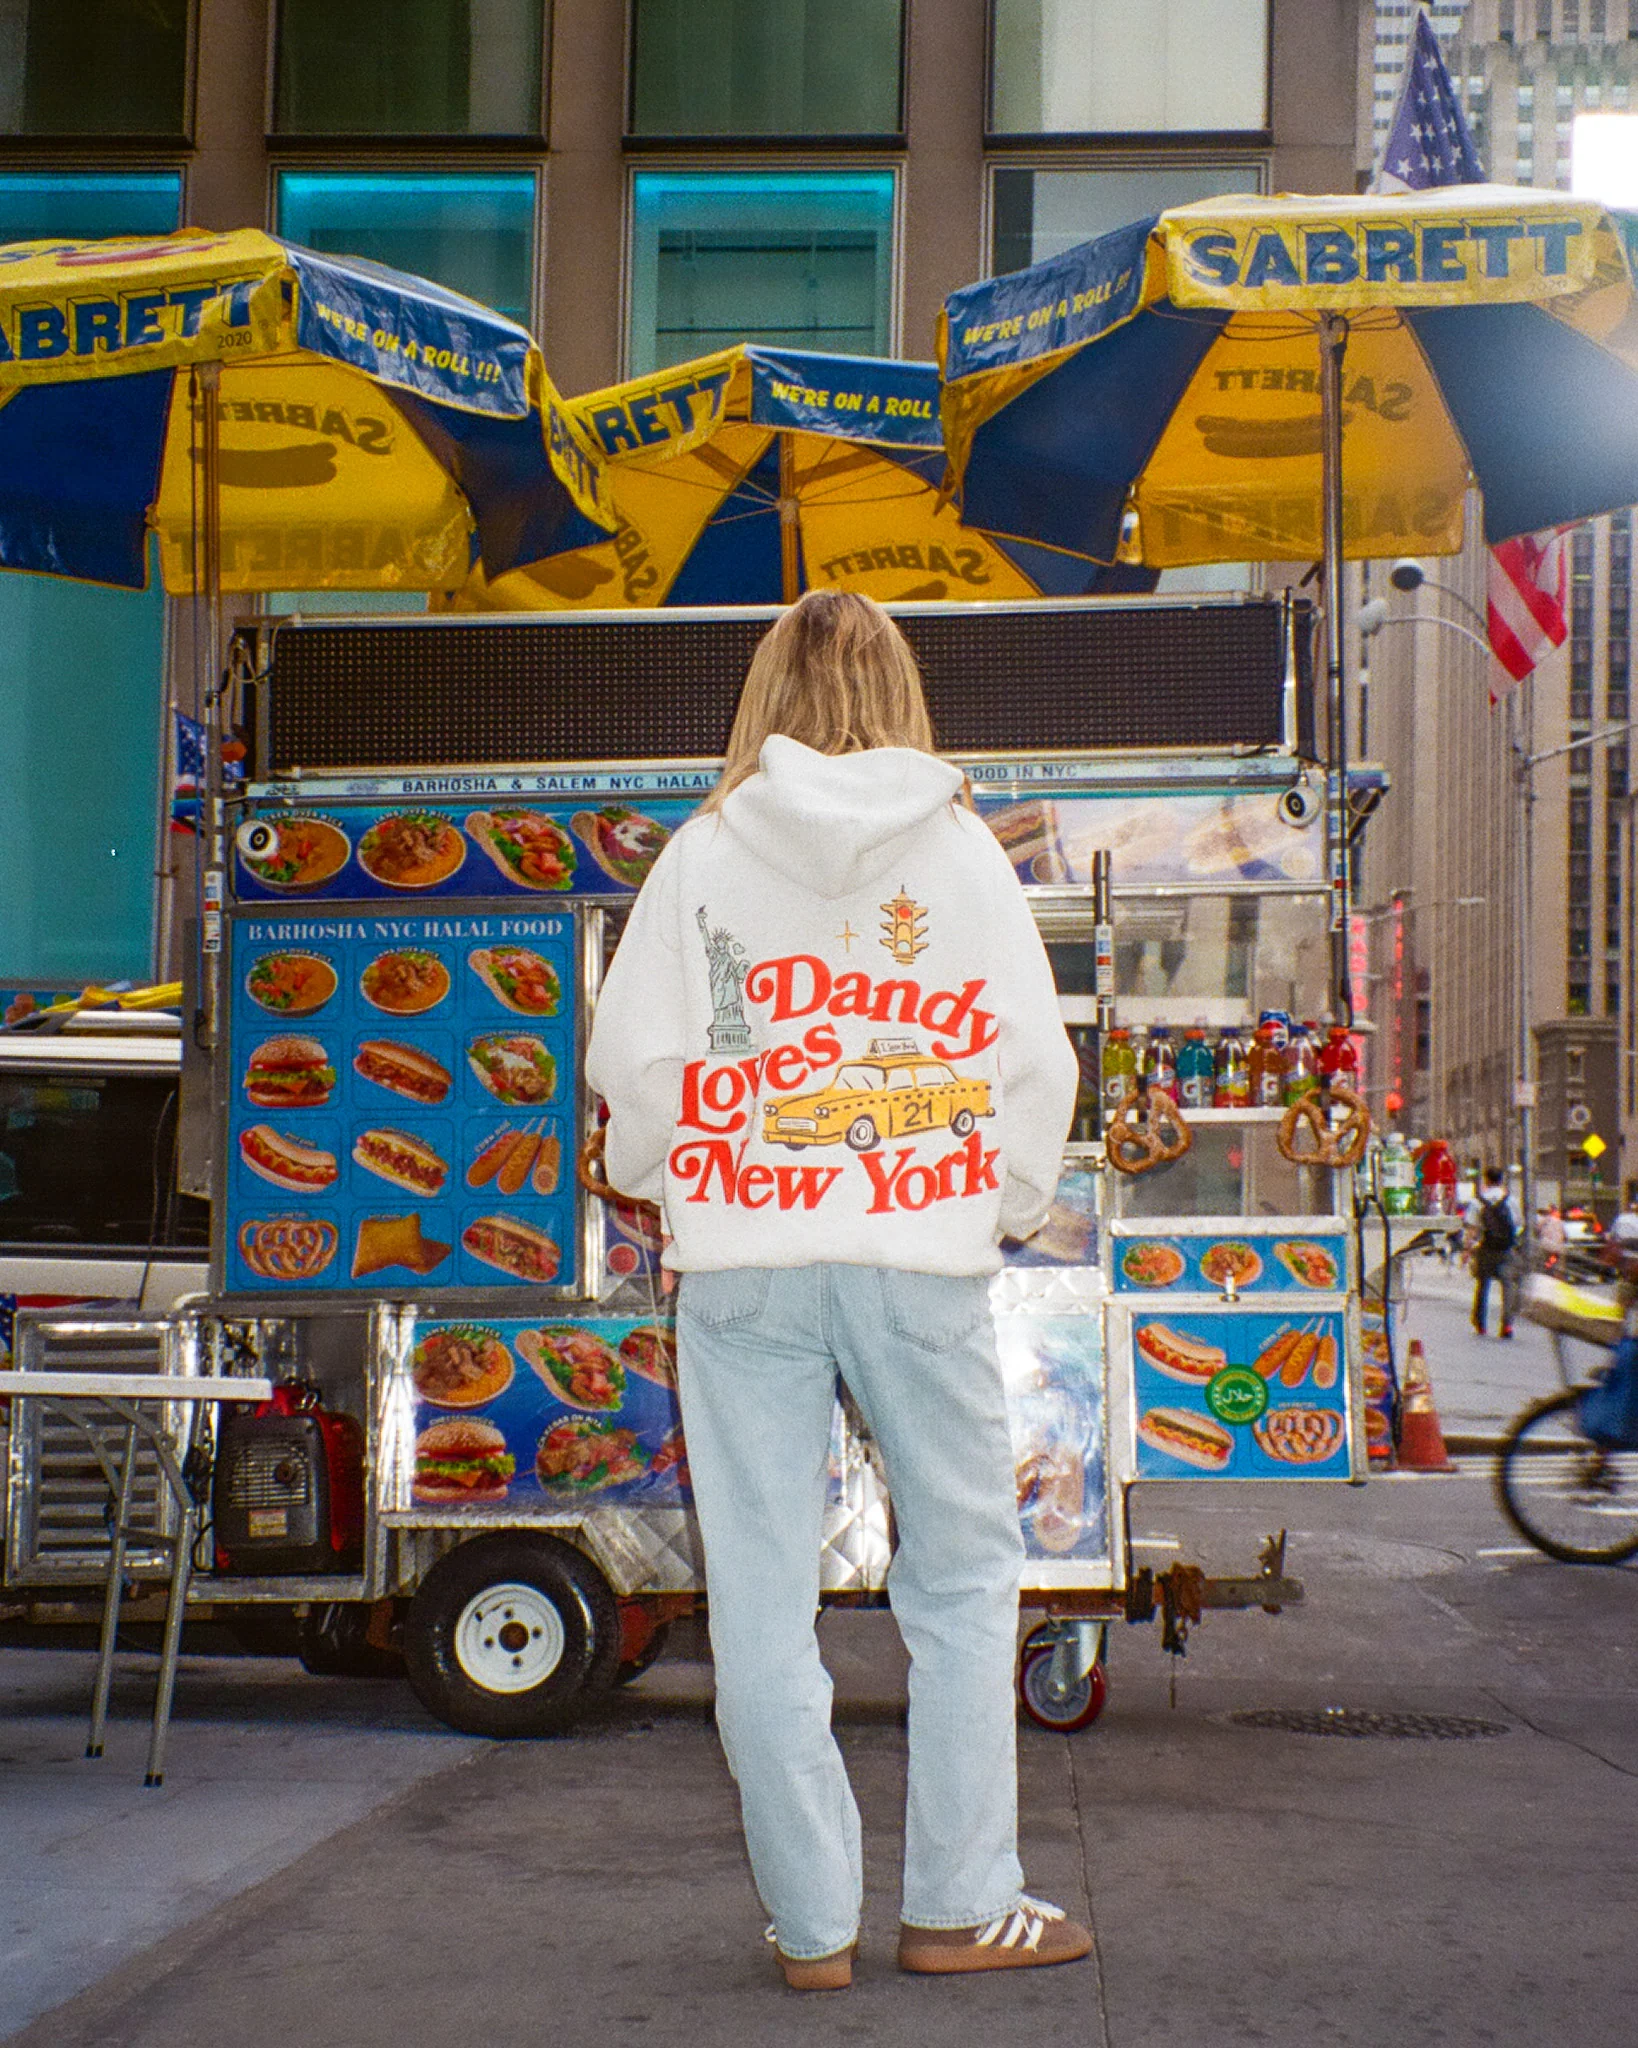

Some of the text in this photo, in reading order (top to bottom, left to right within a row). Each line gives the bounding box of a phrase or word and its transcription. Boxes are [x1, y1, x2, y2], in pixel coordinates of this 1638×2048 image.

[1183, 219, 1583, 288] SABRETT
[0, 273, 264, 361] BRETT
[1027, 305, 1054, 330] ON
[1056, 300, 1068, 318] A
[1072, 282, 1112, 314] ROLL
[217, 330, 252, 348] 2020
[372, 329, 399, 352] ON
[404, 340, 417, 360] A
[422, 345, 470, 376] ROLL
[834, 392, 863, 411] ON
[866, 395, 880, 414] A
[884, 397, 932, 420] ROLL
[402, 777, 497, 793] BARHOSHA
[511, 777, 522, 791] &
[536, 775, 596, 790] SALEM
[610, 776, 643, 789] NYC
[966, 767, 1008, 780] OOD
[1016, 766, 1033, 778] IN
[1043, 763, 1077, 777] NYC
[249, 919, 563, 941] BARHOSHA NYC HALAL FOOD
[745, 954, 1000, 1060] Dandy
[676, 1022, 844, 1134] Loves
[904, 1101, 934, 1127] 21
[669, 1131, 1001, 1215] New York
